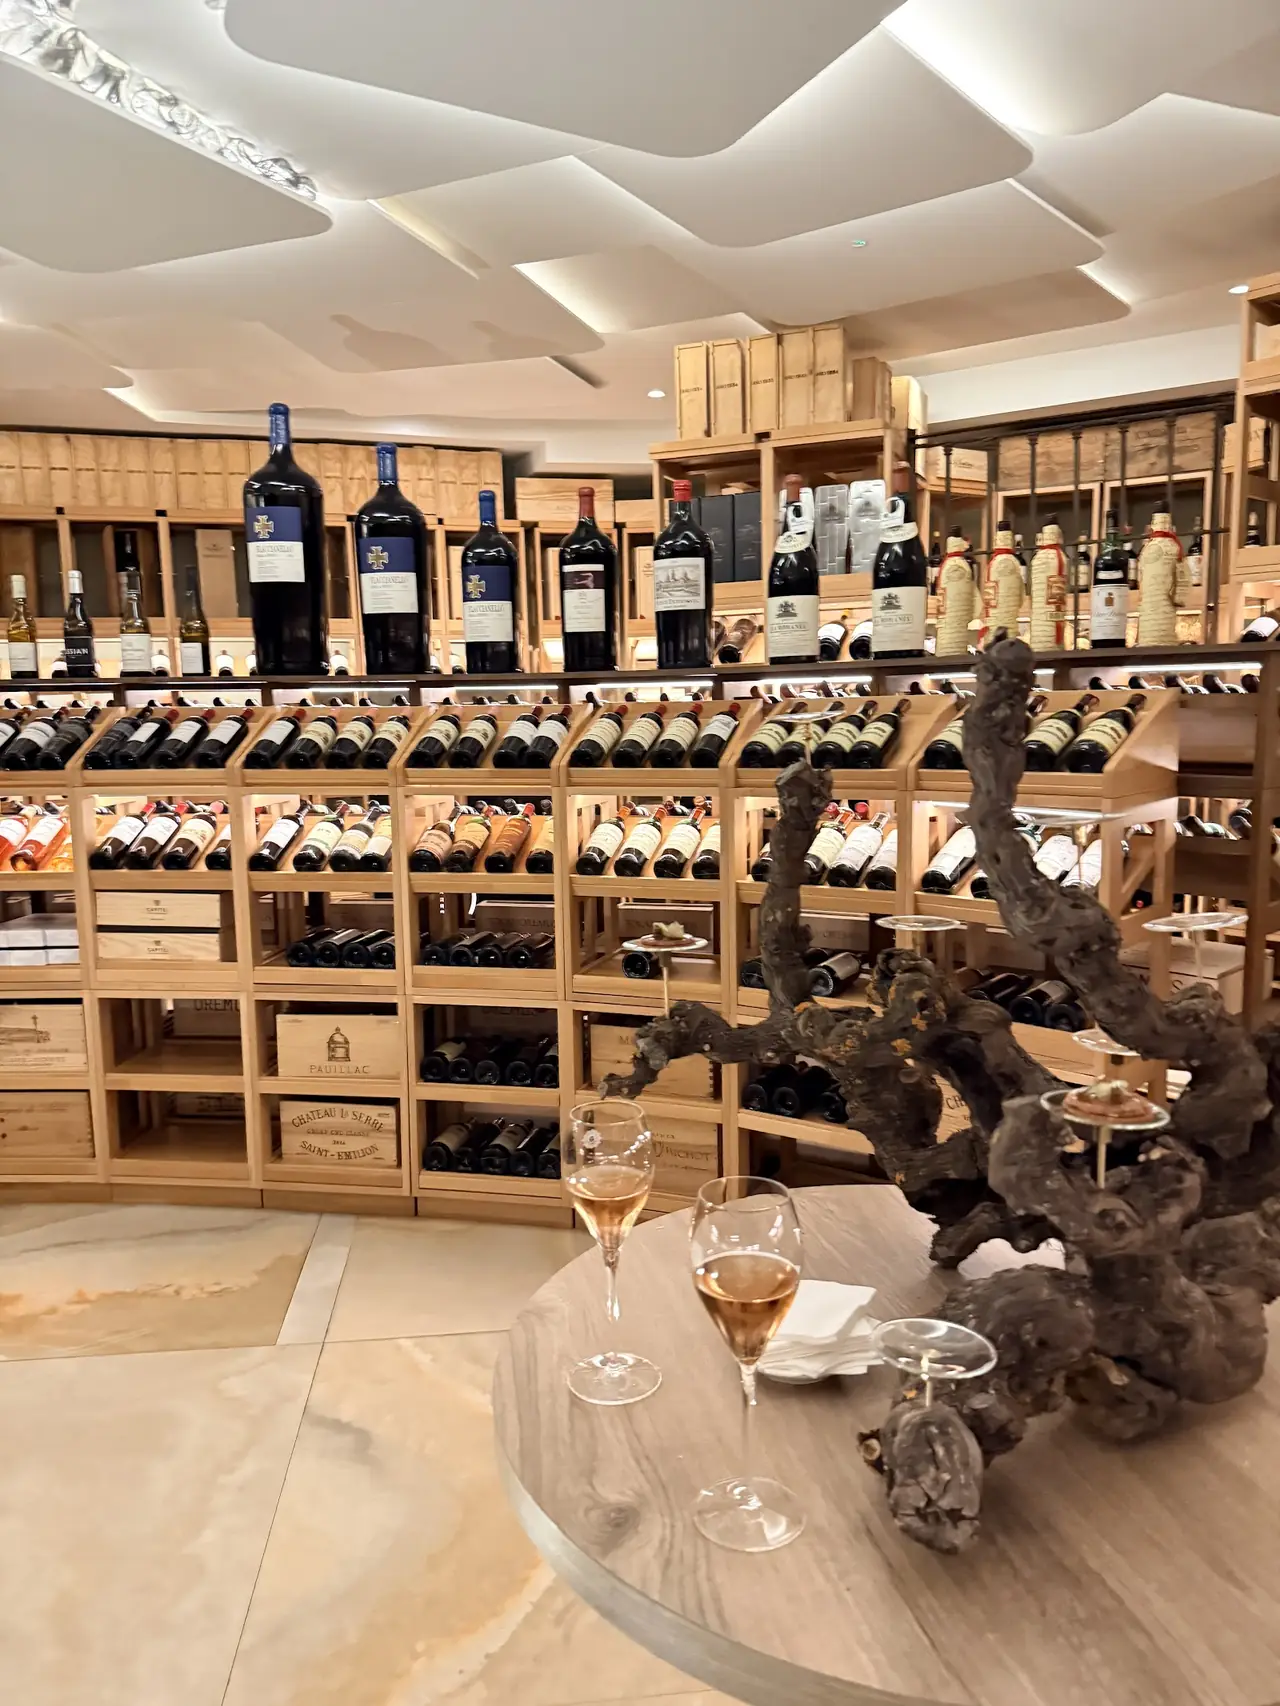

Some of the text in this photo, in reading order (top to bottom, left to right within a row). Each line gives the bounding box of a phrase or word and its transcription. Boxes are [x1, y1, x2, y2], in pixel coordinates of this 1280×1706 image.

[309, 1064, 371, 1075] PAUILLAC
[291, 1107, 337, 1128] CHATEAU
[351, 1110, 384, 1133] SERRE
